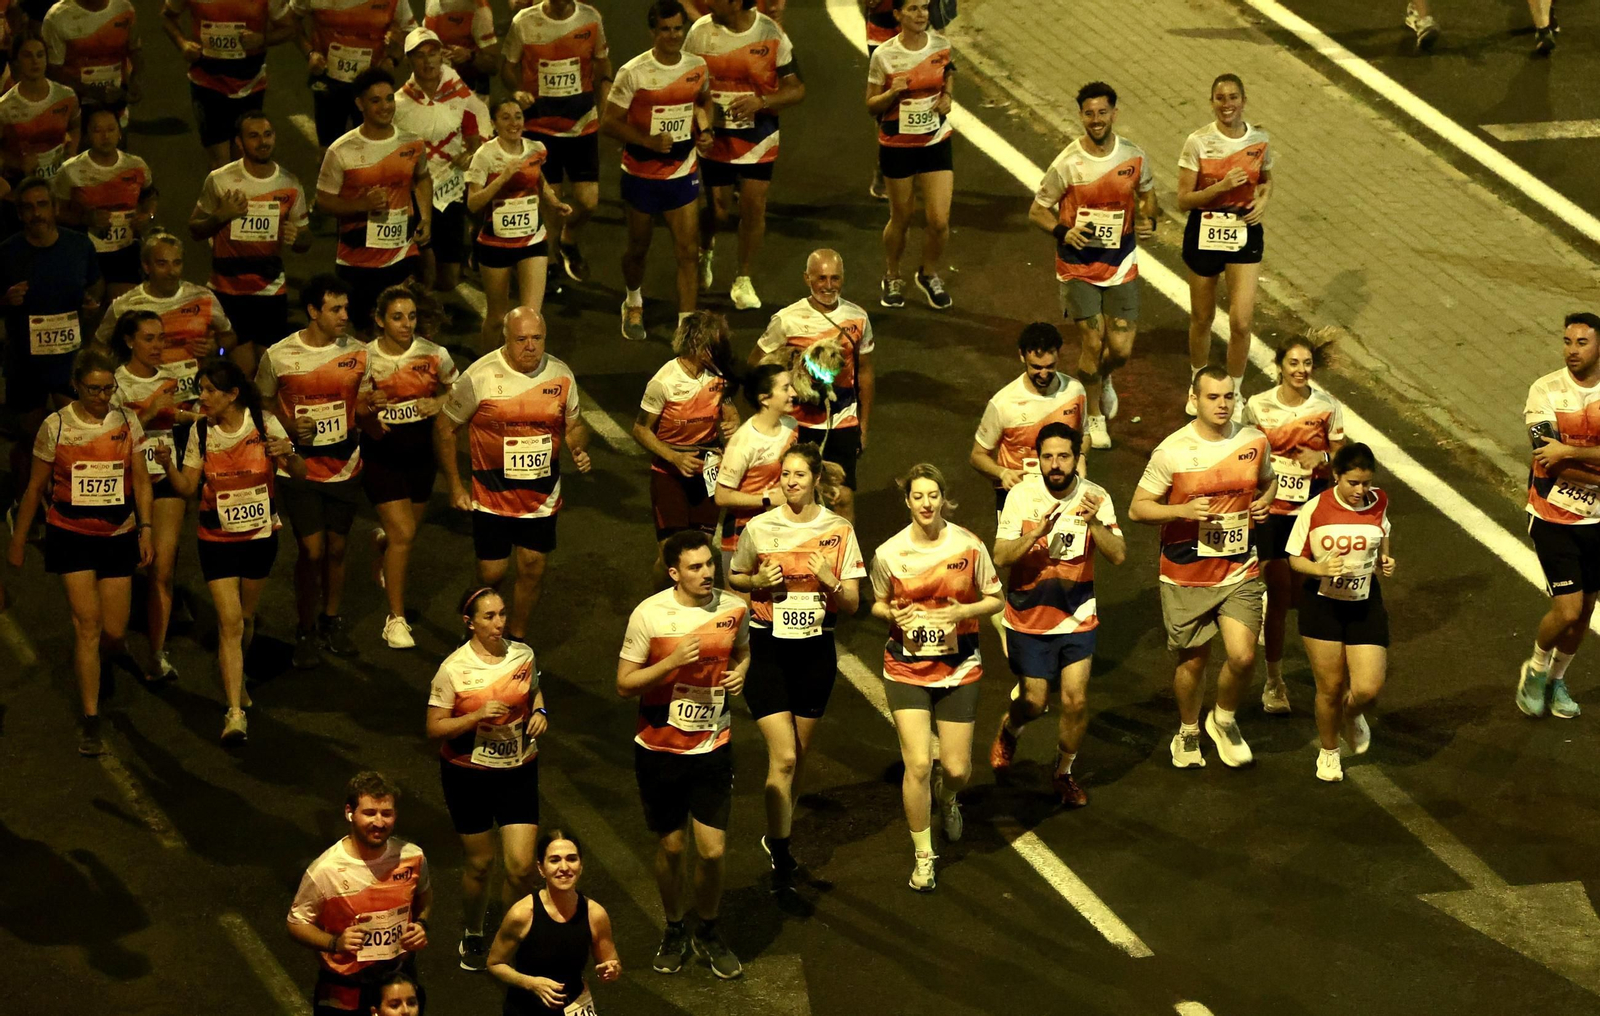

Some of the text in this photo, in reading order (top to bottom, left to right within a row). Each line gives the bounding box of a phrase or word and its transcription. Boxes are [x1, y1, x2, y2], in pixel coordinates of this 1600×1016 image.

[337, 58, 358, 73] 934
[542, 73, 576, 87] 14779
[907, 110, 933, 125] 5399
[659, 119, 685, 132] 3007
[434, 176, 460, 201] 17232
[240, 217, 270, 231] 7100
[501, 213, 530, 228] 6475
[376, 224, 402, 238] 7099
[1207, 228, 1238, 242] 8154
[36, 328, 75, 344] 13756
[543, 386, 560, 396] KH7
[382, 405, 419, 420] 20309
[510, 452, 548, 468] 11367
[1238, 449, 1256, 461] KH7
[78, 478, 118, 493] 15757
[1557, 482, 1597, 506] 24543
[224, 503, 265, 521] 12306
[819, 536, 839, 547] KH7
[1205, 529, 1243, 545] 19785
[1321, 534, 1367, 556] oga
[947, 560, 967, 571] KH7
[1329, 576, 1367, 590] 19787
[717, 618, 734, 628] KH7
[782, 611, 816, 626] 9885
[912, 629, 946, 643] 9882
[677, 702, 716, 719] 10721
[481, 740, 518, 755] 13003
[393, 869, 412, 882] KH7
[363, 924, 403, 947] 20258
